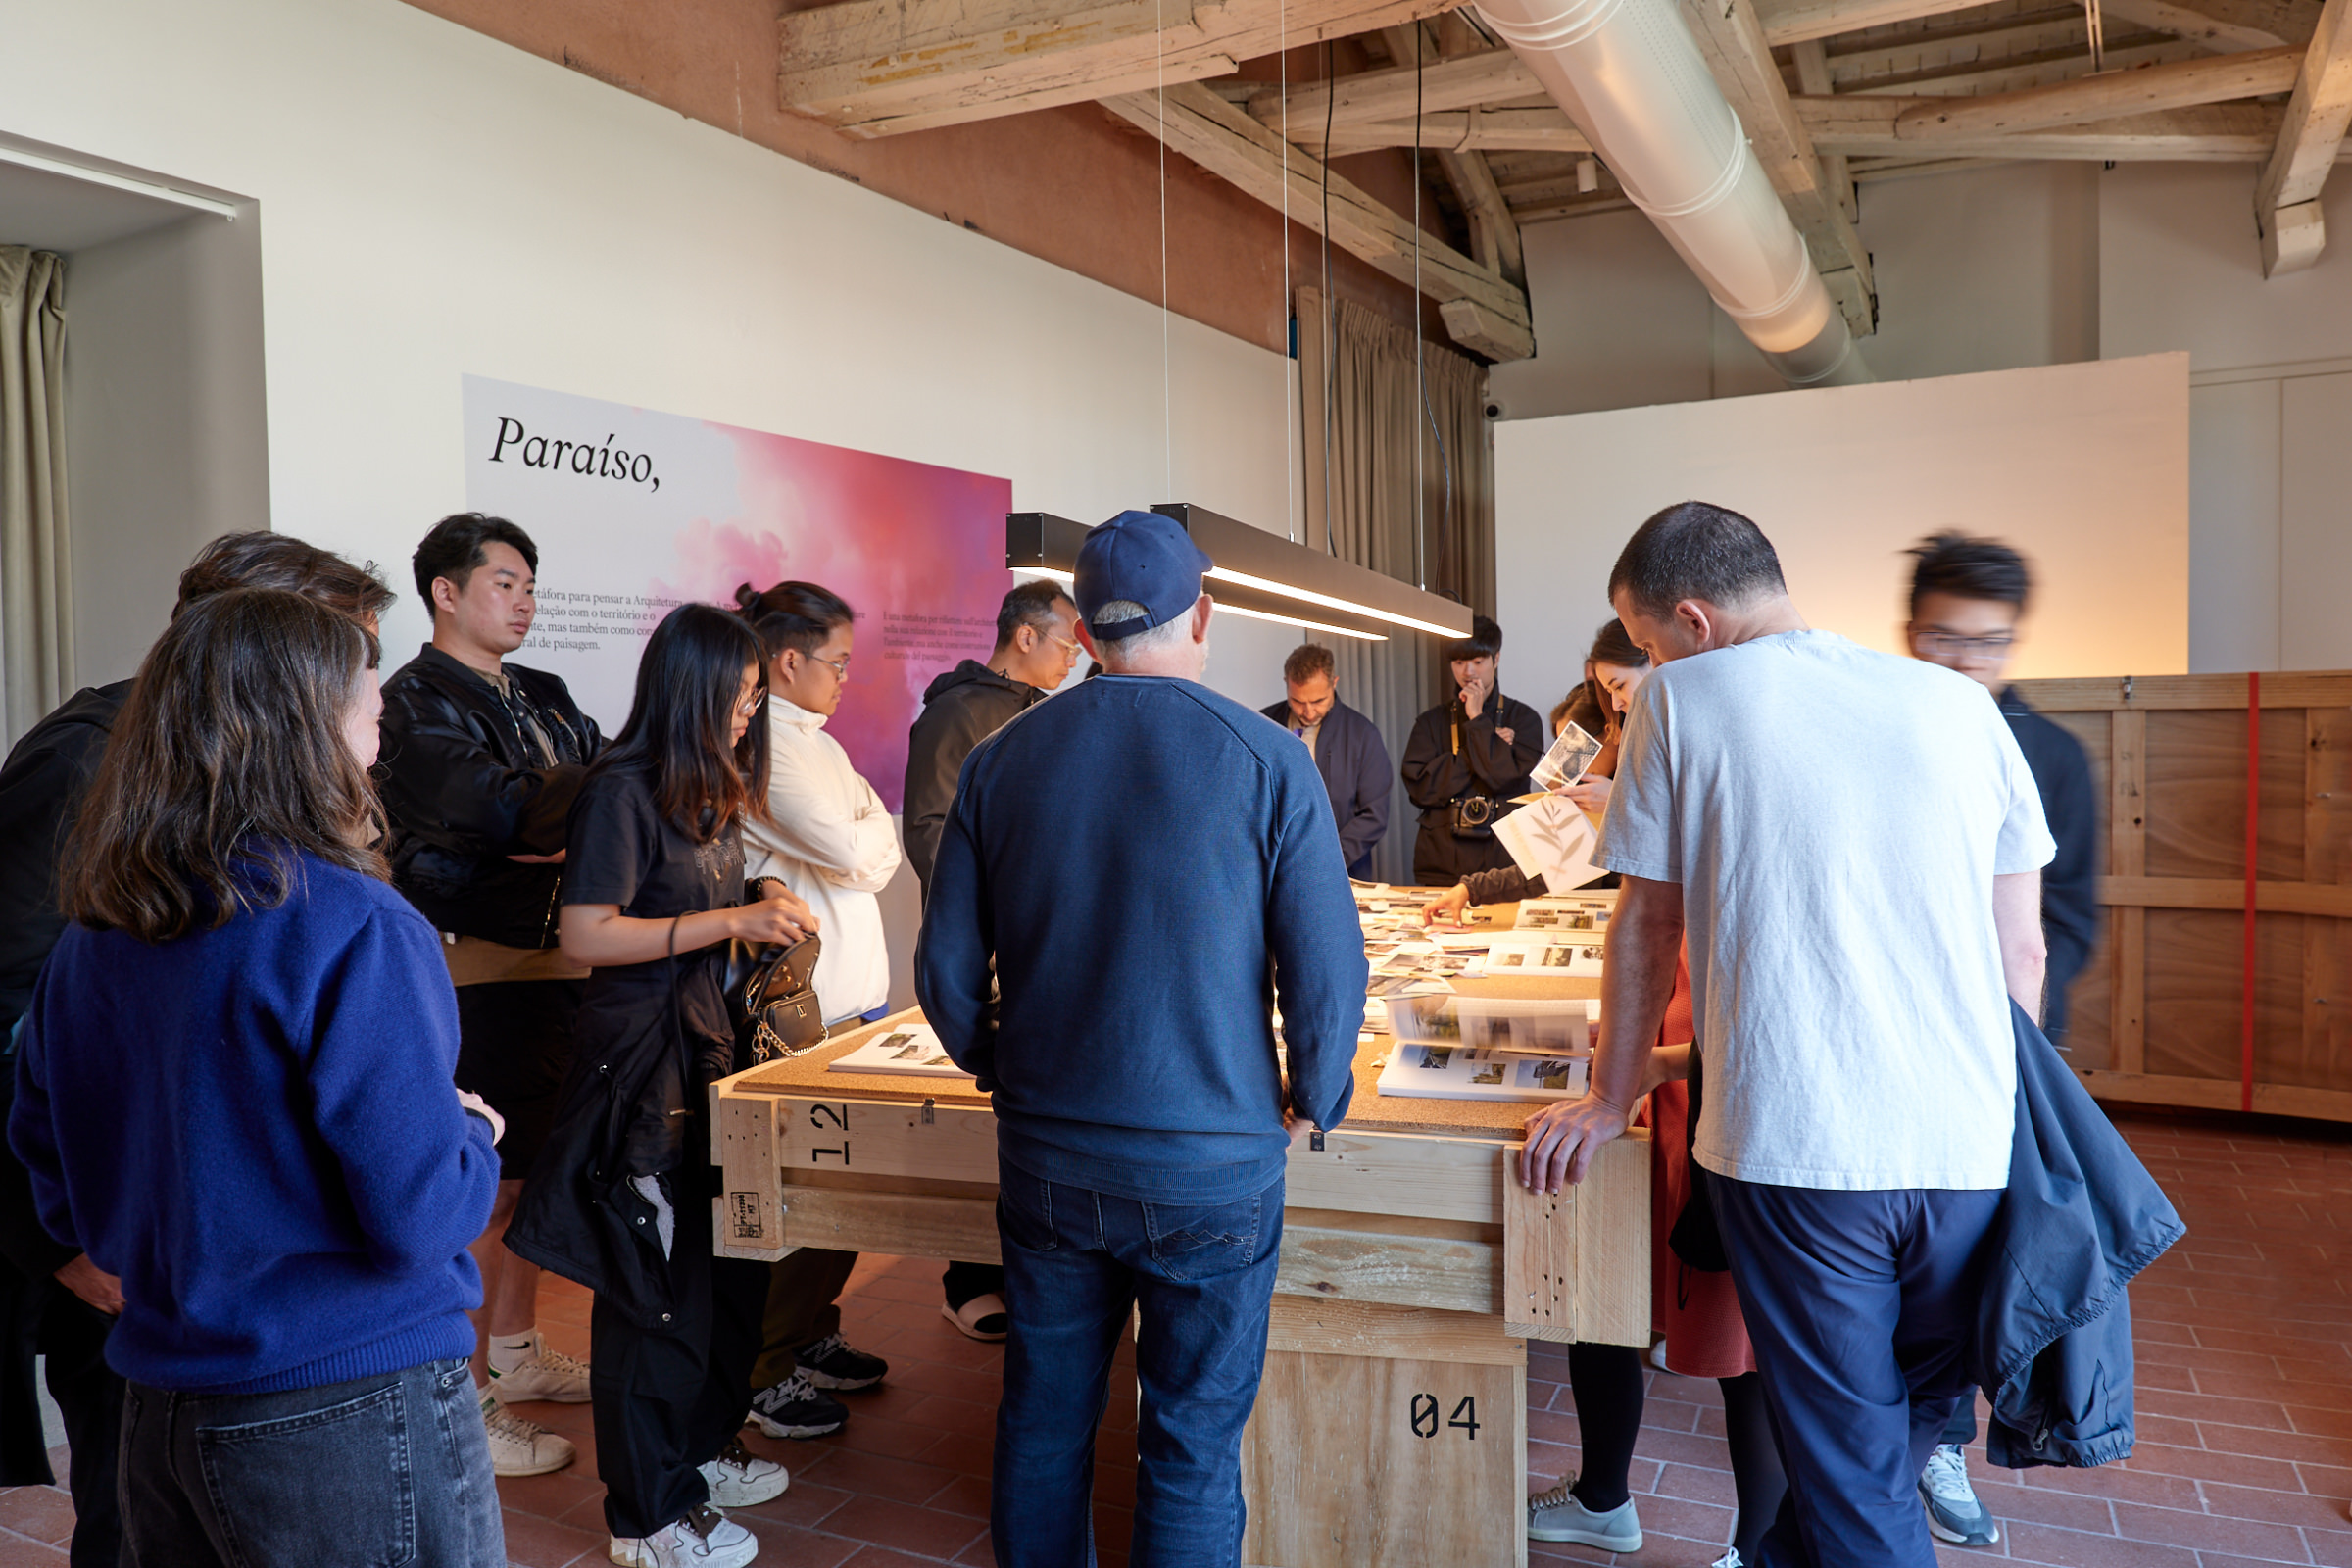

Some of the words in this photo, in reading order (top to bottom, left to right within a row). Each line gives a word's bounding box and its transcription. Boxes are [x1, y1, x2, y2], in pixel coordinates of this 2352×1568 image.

[489, 416, 660, 493] Paraíso,
[533, 588, 566, 601] etáfora
[568, 592, 591, 604] para
[593, 593, 623, 605] pensar
[633, 595, 683, 609] Arquitetura
[535, 605, 566, 618] elação
[568, 608, 589, 617] com
[599, 608, 641, 620] território
[548, 624, 567, 633] mas
[569, 622, 609, 635] também
[610, 626, 636, 636] como
[539, 637, 551, 648] de
[553, 638, 601, 653] paisagem.
[809, 1103, 850, 1165] 12
[1411, 1393, 1481, 1441] 04
